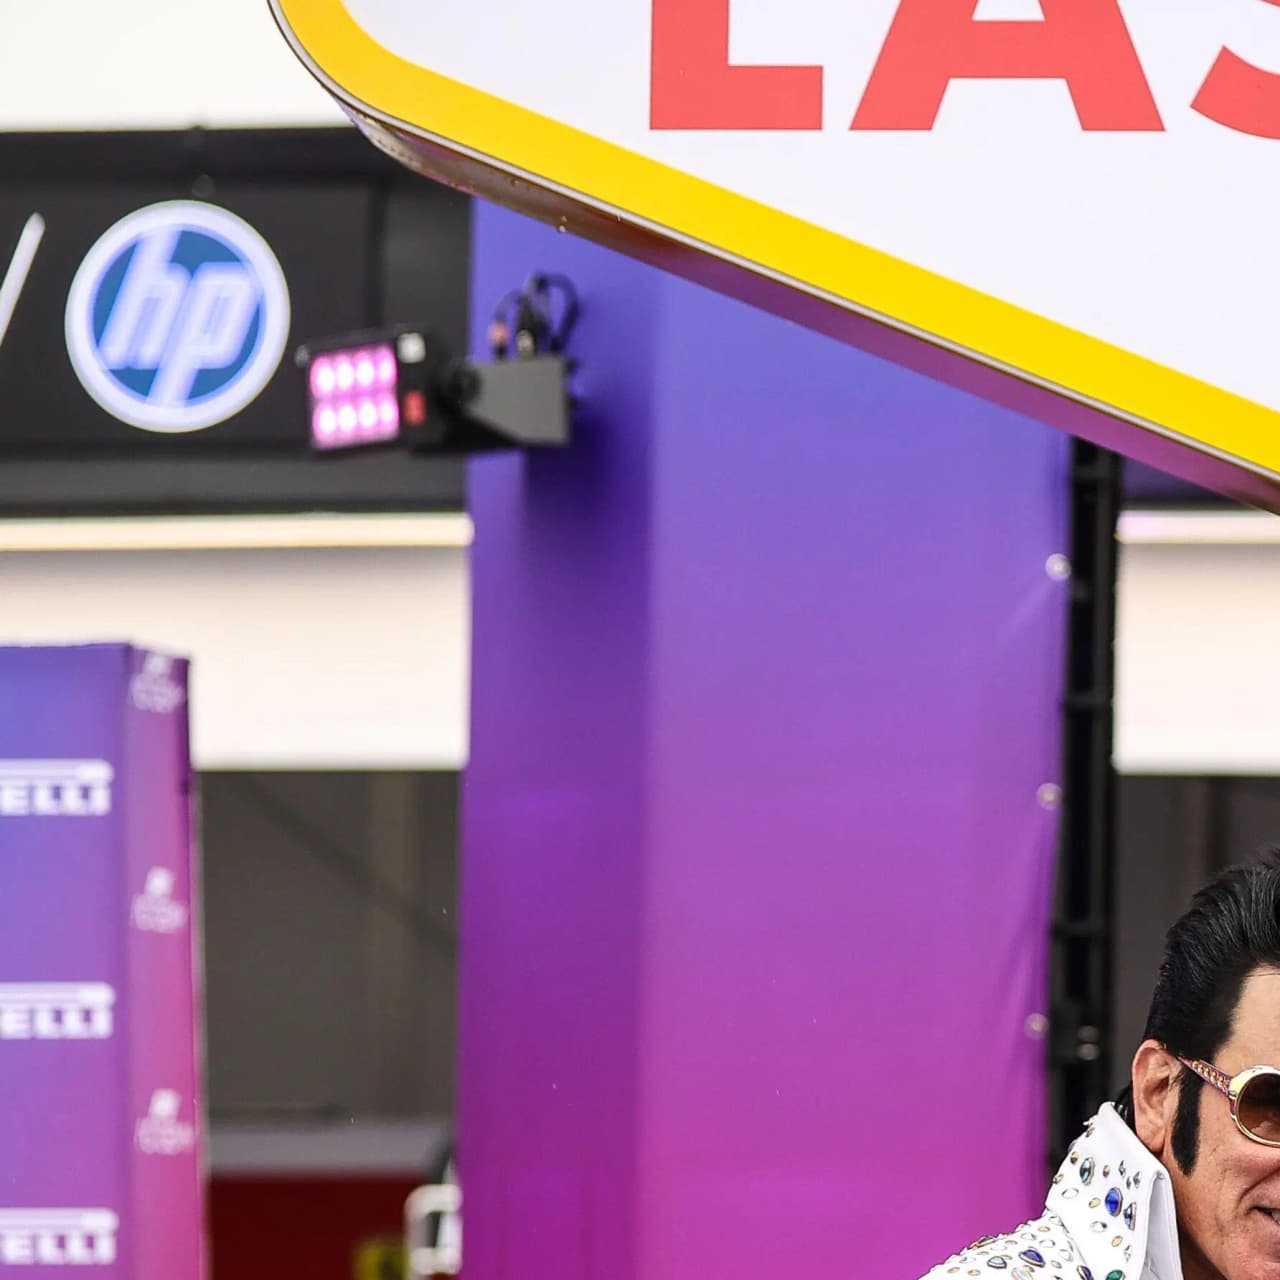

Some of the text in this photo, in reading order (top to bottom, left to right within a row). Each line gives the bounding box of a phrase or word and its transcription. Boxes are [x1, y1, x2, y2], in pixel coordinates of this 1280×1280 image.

[94, 222, 266, 410] hp
[0, 759, 114, 816] ELLI
[0, 981, 116, 1039] ELLI
[0, 1208, 119, 1265] ELLI
